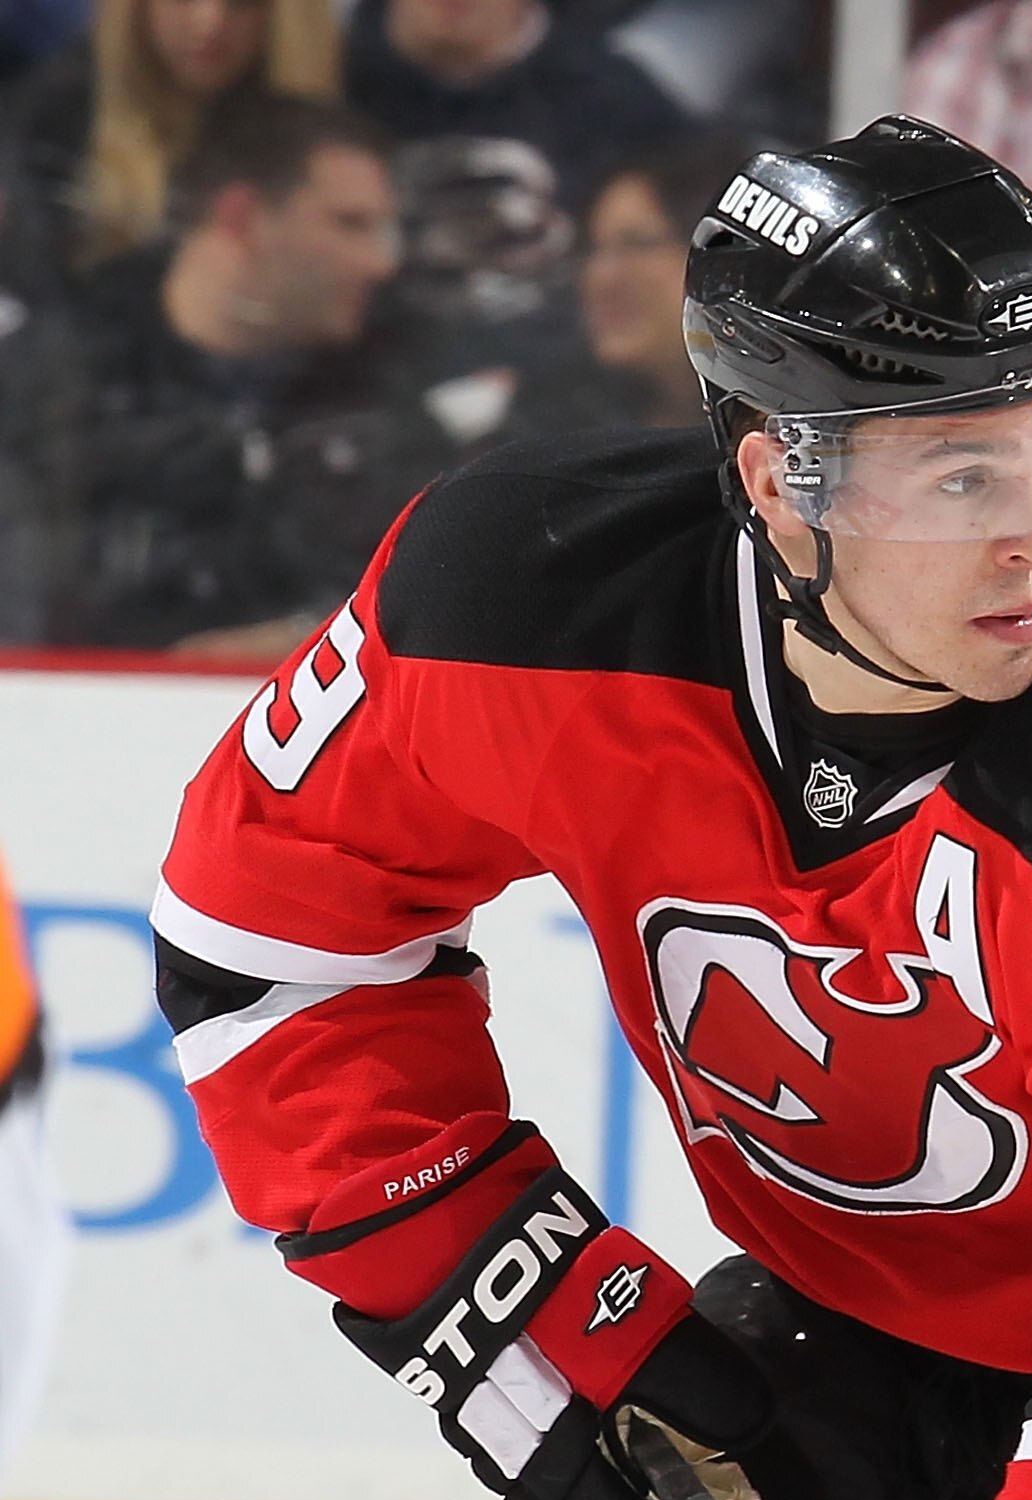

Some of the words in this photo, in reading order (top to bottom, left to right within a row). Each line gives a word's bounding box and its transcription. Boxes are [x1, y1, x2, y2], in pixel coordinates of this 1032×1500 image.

[717, 174, 819, 256] DEVILS
[243, 592, 367, 792] 9
[811, 787, 845, 807] NHL
[915, 832, 996, 1028] A
[383, 1145, 470, 1201] PARISE
